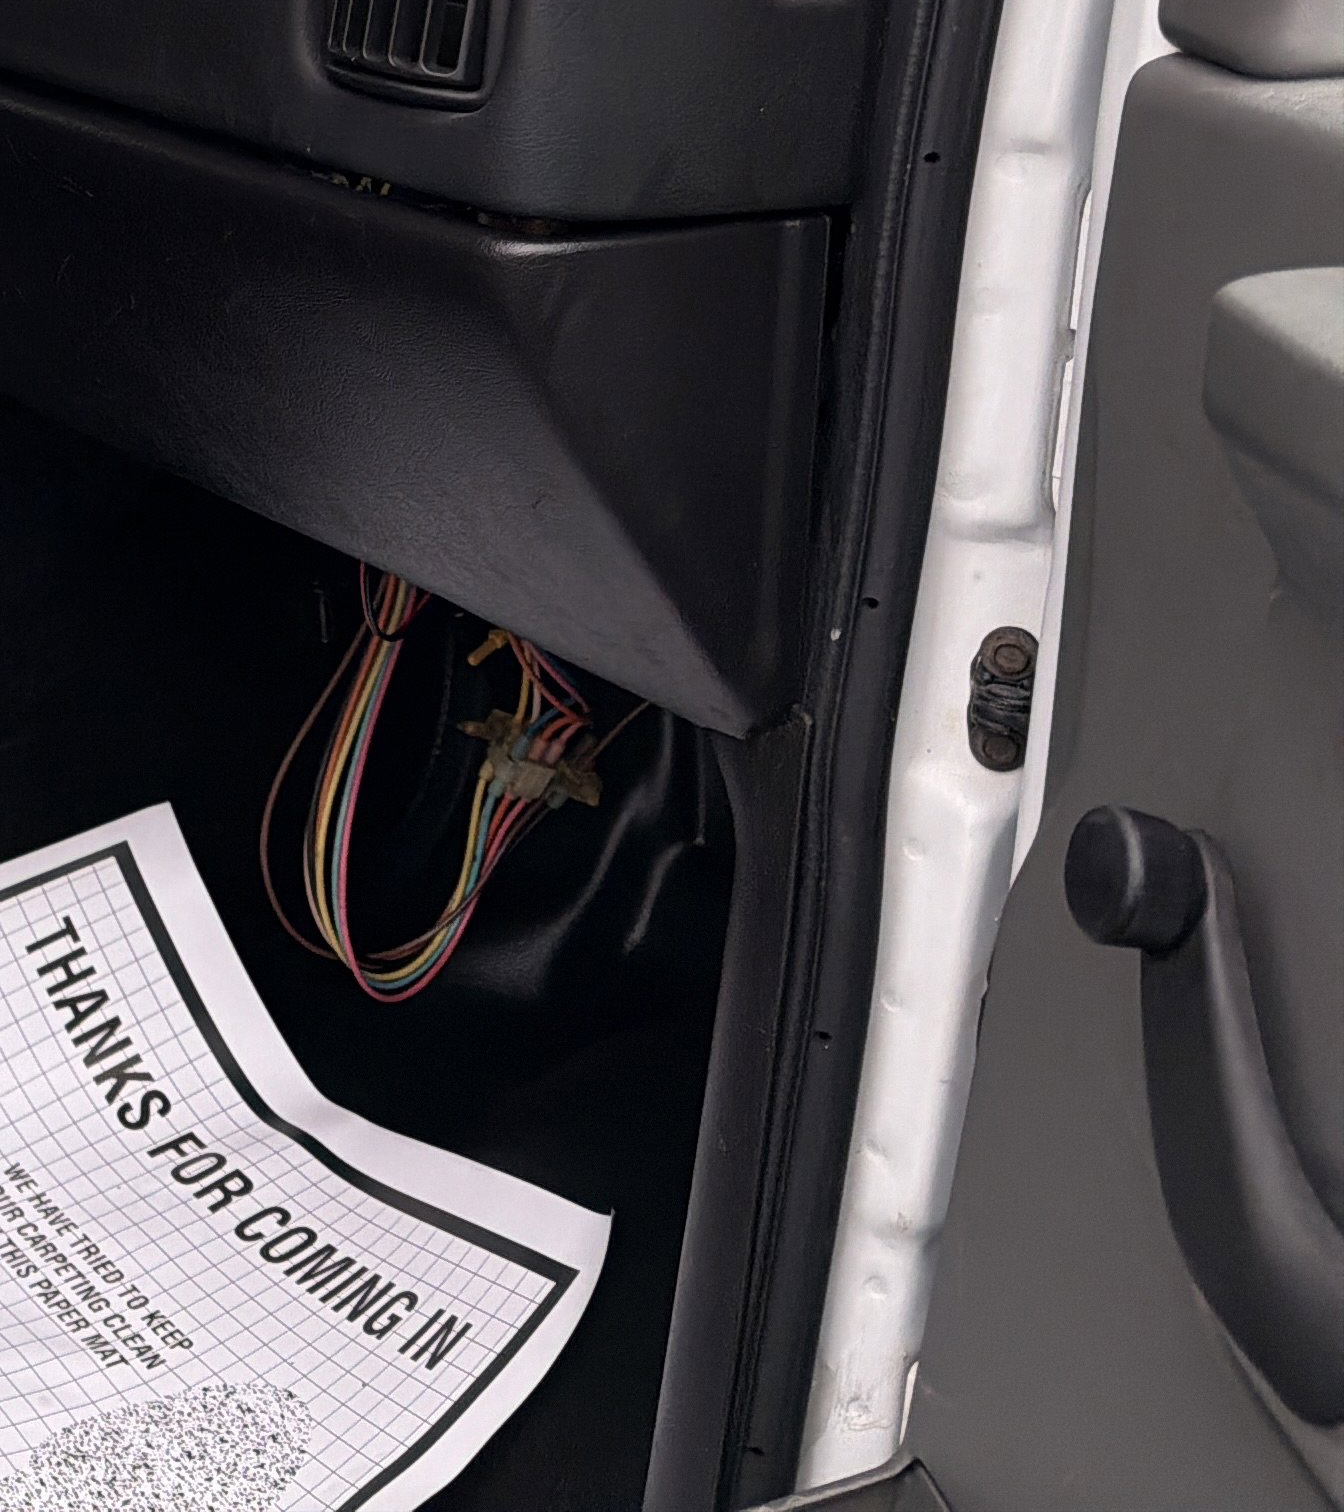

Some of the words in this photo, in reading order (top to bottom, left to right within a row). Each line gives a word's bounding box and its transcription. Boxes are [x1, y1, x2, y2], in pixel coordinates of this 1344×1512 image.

[25, 916, 171, 1130] THANKS
[147, 1132, 254, 1213] FOR
[234, 1206, 419, 1341] COMING
[398, 1309, 473, 1371] IN
[4, 1163, 39, 1193] WE
[28, 1193, 80, 1237] HAVE
[70, 1233, 125, 1284] TRIED
[118, 1284, 150, 1310] TO
[141, 1310, 194, 1350] KEEP
[17, 1222, 111, 1313] CARPETING
[103, 1313, 167, 1370] CLEAN
[29, 1278, 91, 1333] PAPER
[81, 1333, 129, 1368] MAT
